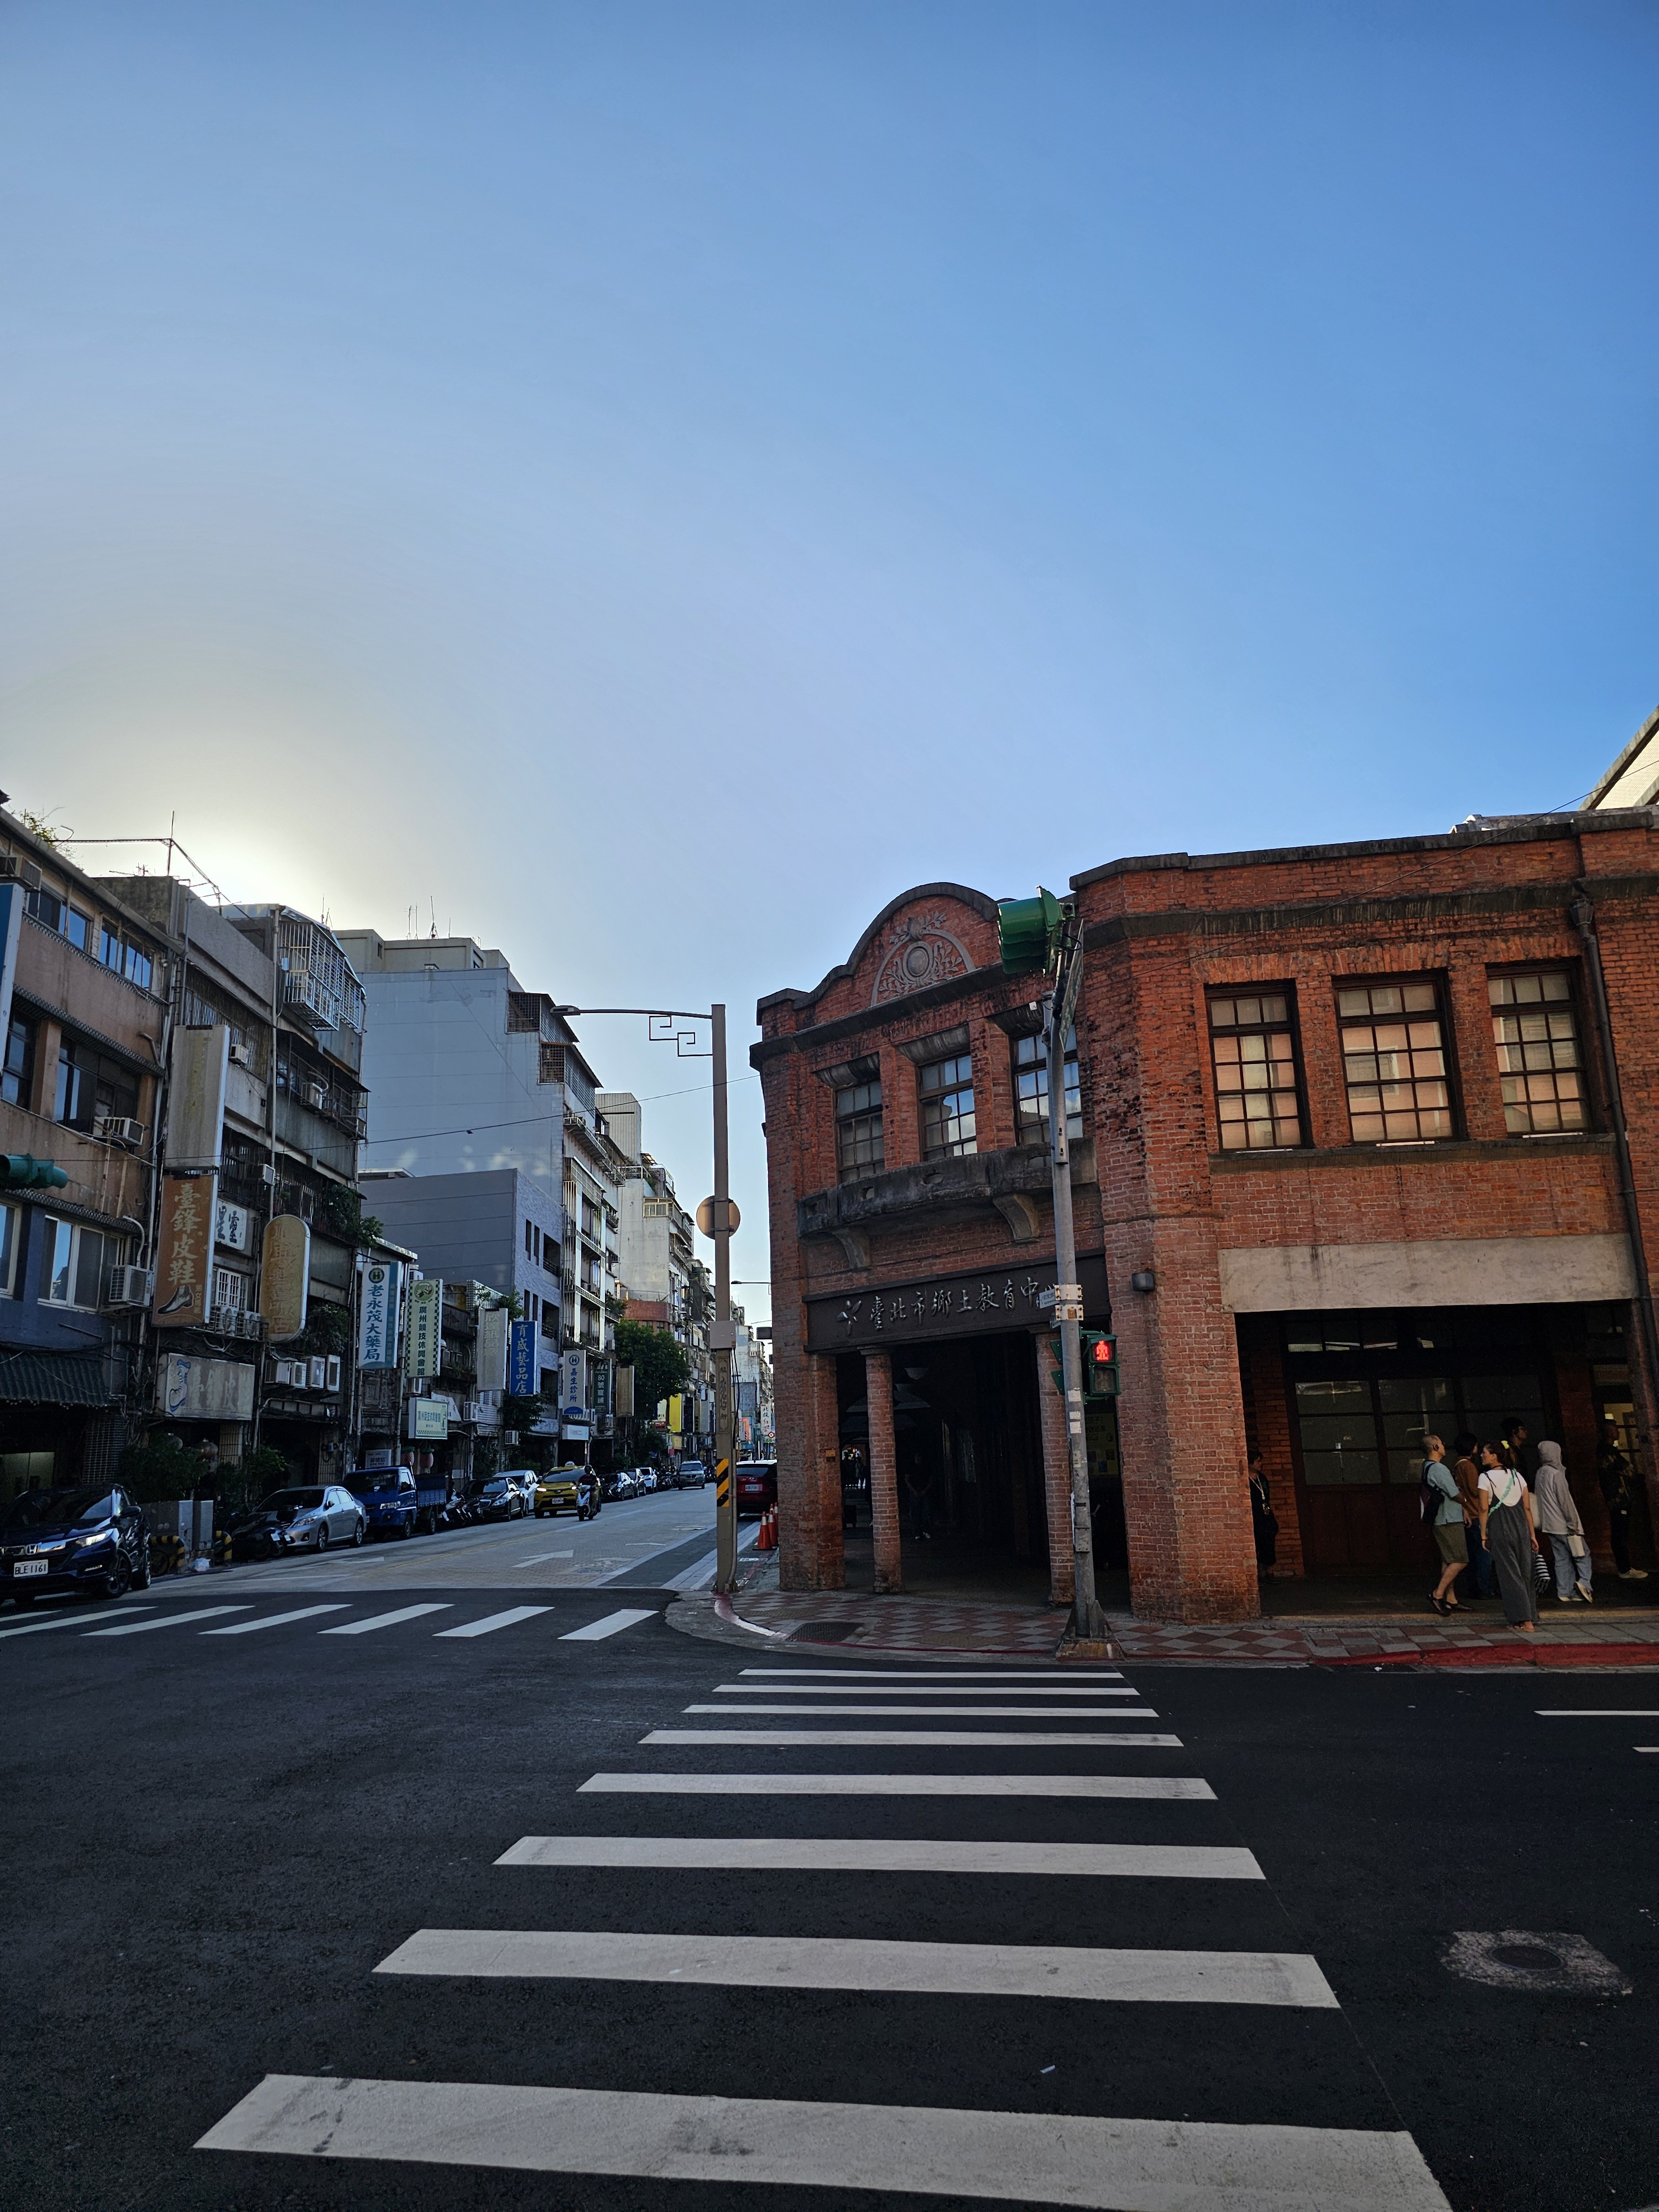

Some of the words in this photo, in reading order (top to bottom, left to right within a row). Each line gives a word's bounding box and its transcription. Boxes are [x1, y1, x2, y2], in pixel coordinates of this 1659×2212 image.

[168, 1183, 203, 1286] 臺鋒皮鞋
[363, 1284, 385, 1361] 老永茂大藥局
[515, 1323, 529, 1394] 育盛藝品店
[569, 1368, 578, 1402] 嘉生診所
